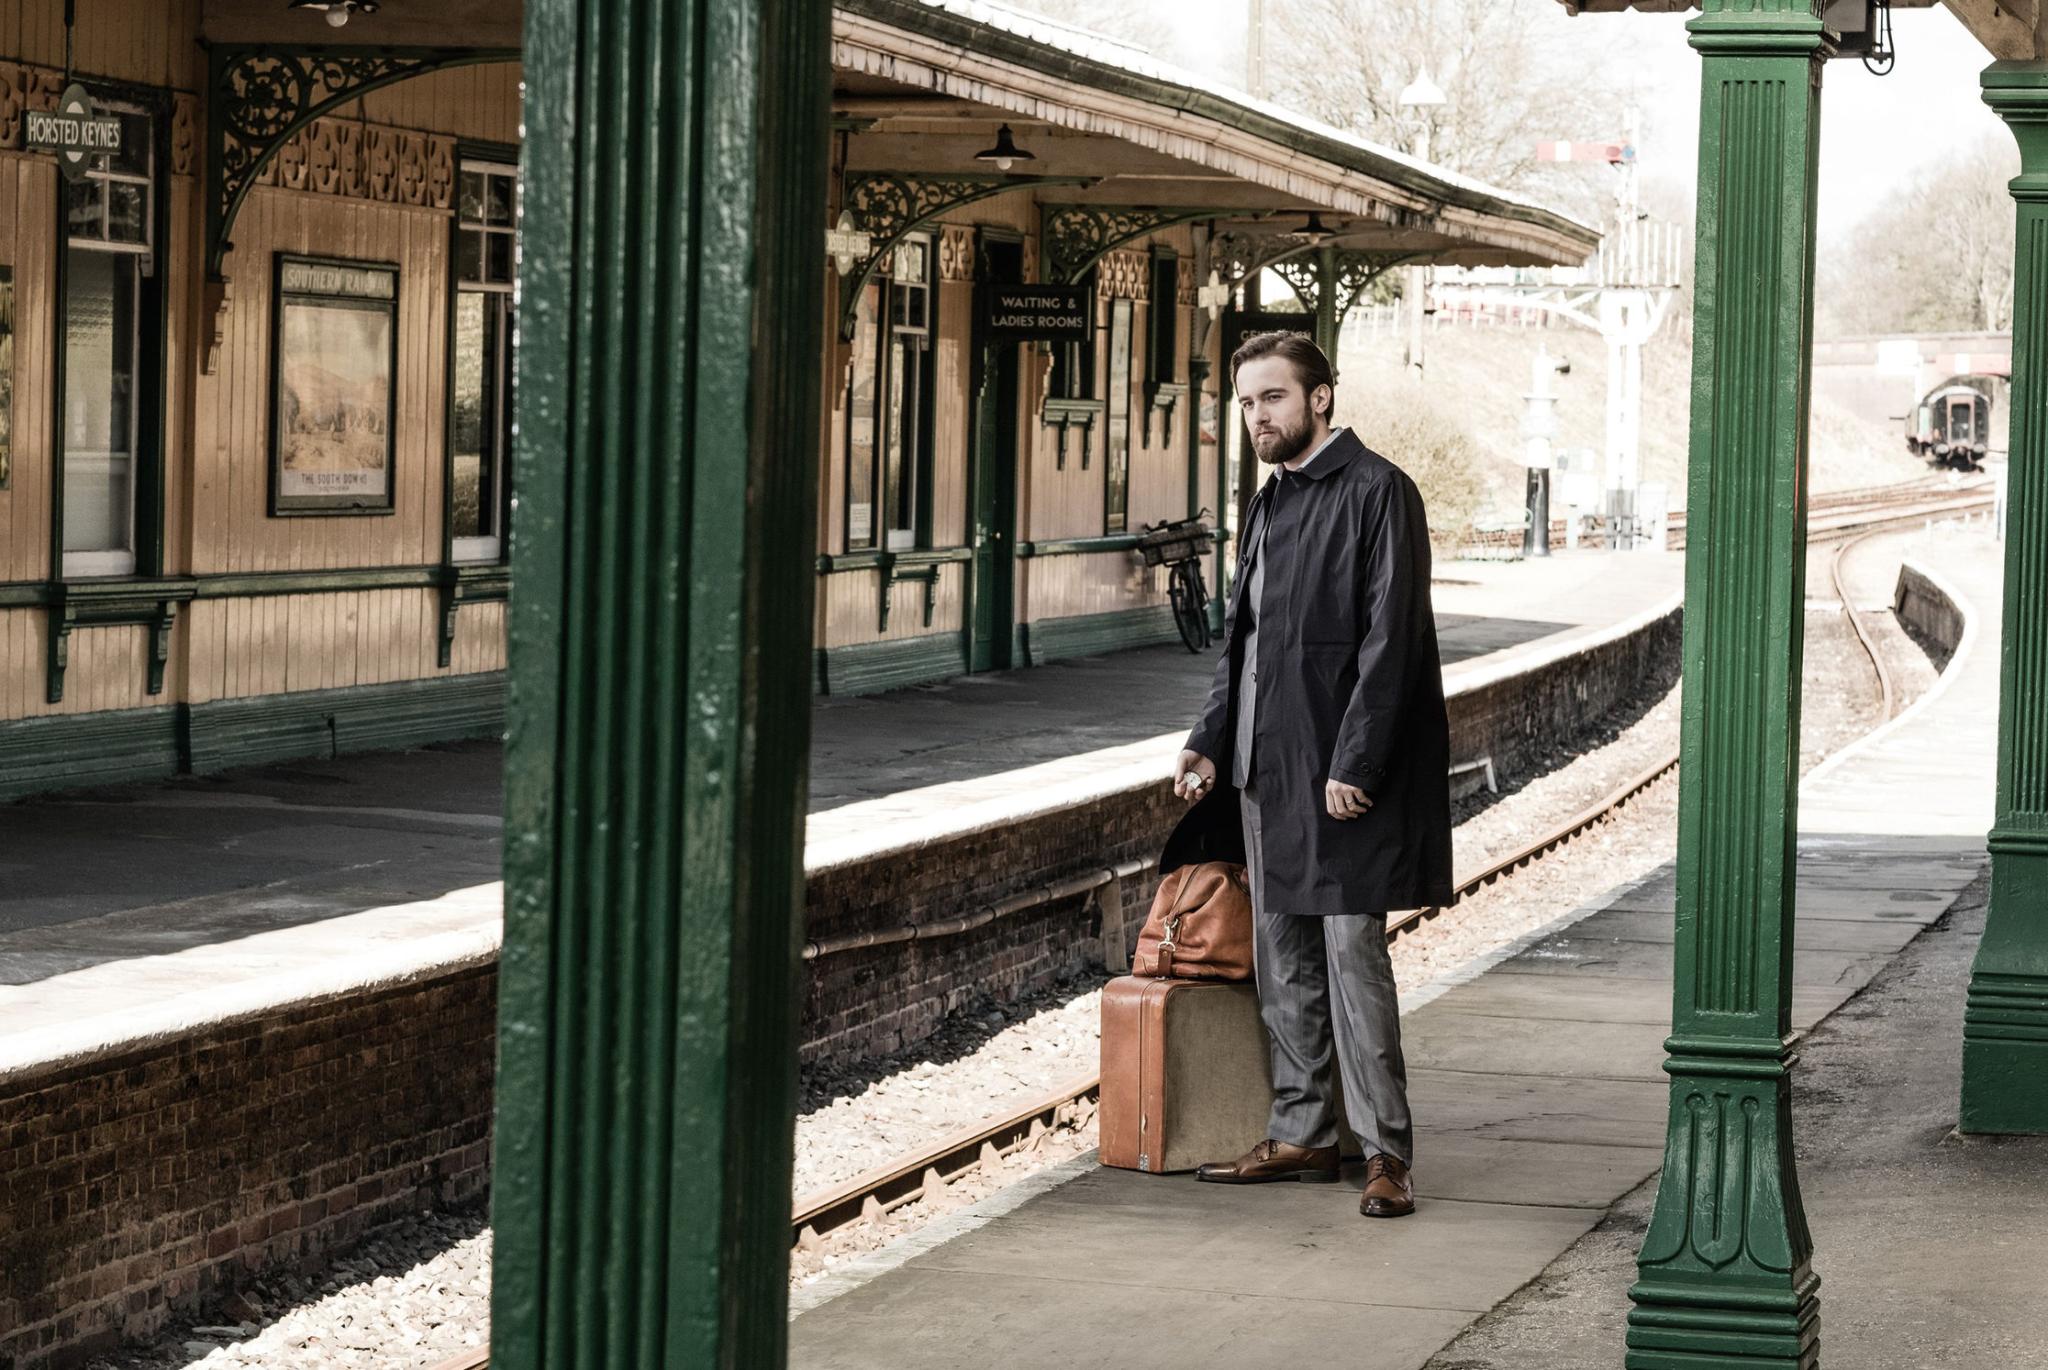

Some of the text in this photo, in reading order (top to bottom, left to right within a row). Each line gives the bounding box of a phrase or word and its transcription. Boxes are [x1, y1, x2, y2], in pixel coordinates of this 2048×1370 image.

[28, 116, 120, 148] HORSTED KEYNES
[287, 268, 341, 290] SOUTHERN
[1001, 296, 1076, 309] WAITING &
[992, 315, 1083, 328] LADIES ROOMS
[301, 473, 314, 484] THE
